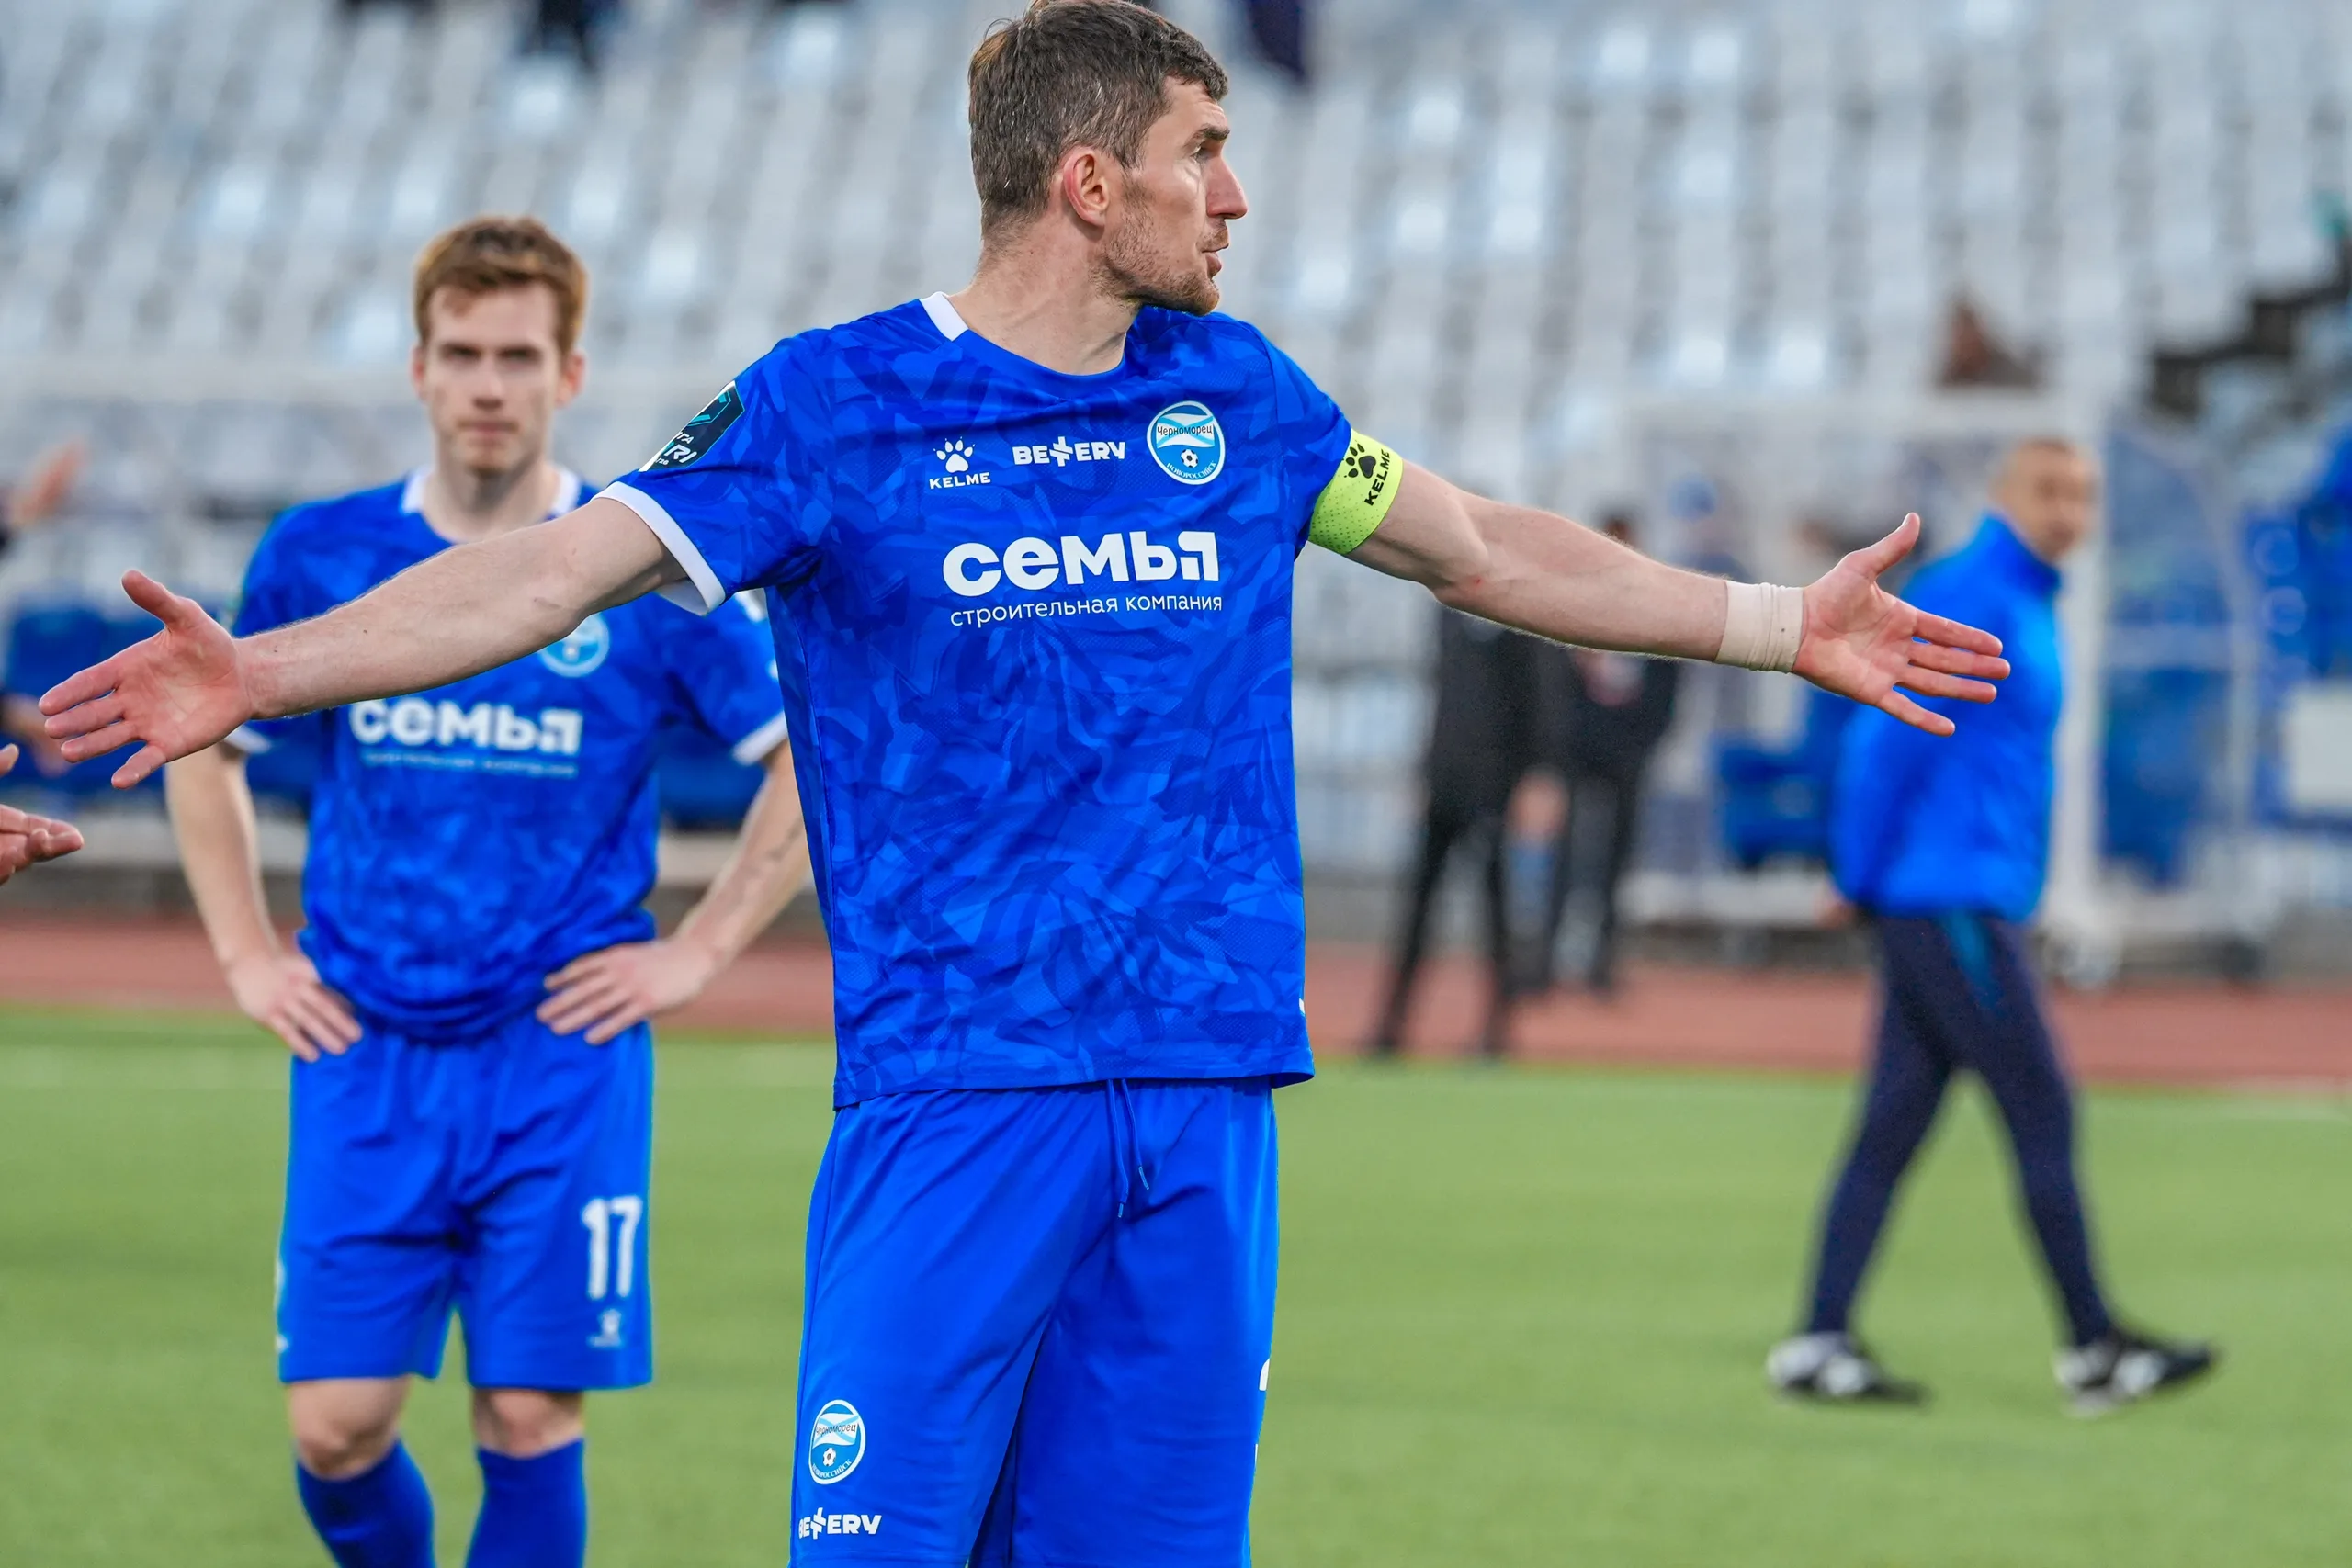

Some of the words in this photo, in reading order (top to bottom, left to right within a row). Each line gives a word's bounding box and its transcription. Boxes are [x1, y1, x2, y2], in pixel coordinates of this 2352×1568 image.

[1158, 425, 1212, 437] Черноморец
[929, 472, 991, 489] KELME
[1364, 449, 1390, 506] KELME
[950, 597, 1118, 627] строительная
[1125, 595, 1222, 611] компания
[582, 1196, 642, 1300] 17
[816, 1423, 856, 1437] Черноморец
